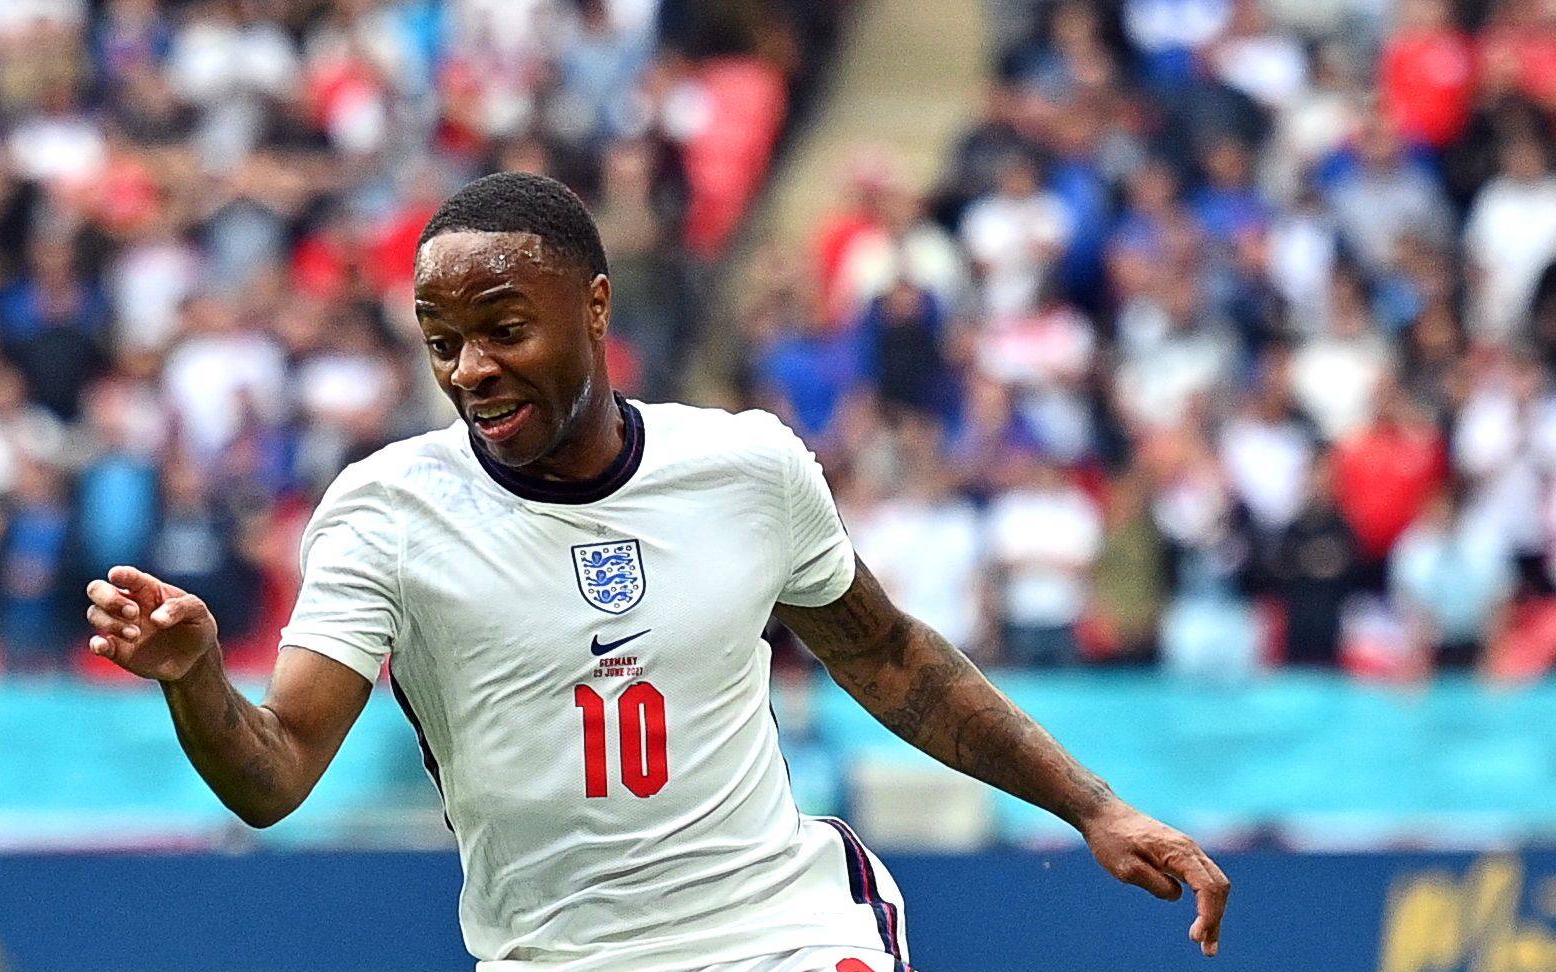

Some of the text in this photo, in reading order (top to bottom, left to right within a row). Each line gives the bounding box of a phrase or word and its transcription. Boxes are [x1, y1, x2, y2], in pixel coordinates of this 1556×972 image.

[599, 656, 638, 667] GERMANY
[605, 668, 624, 677] JUNE
[574, 681, 668, 798] 10
